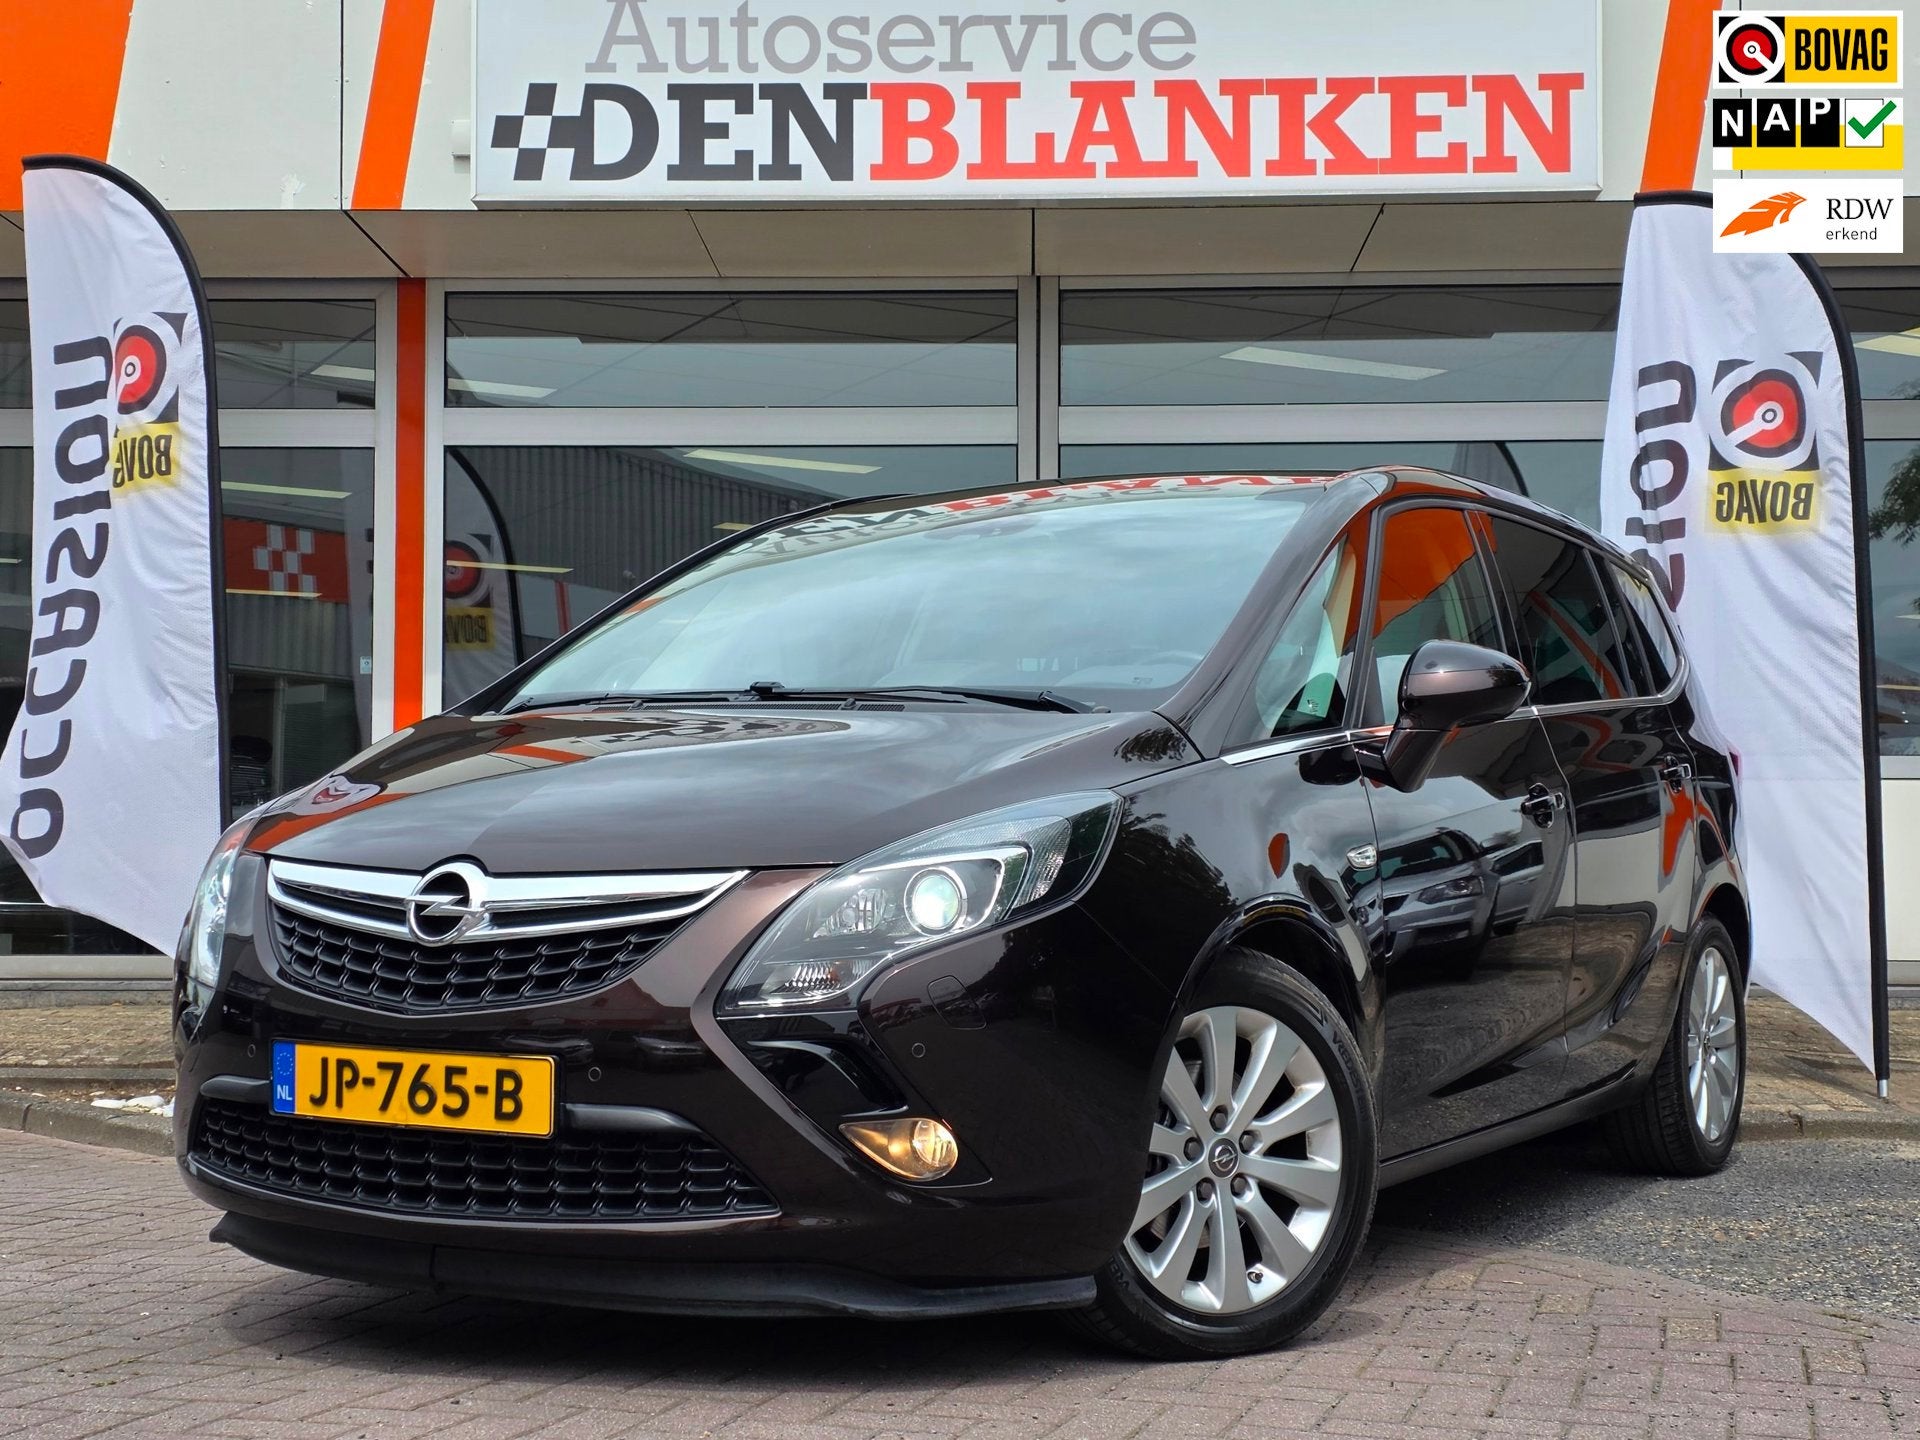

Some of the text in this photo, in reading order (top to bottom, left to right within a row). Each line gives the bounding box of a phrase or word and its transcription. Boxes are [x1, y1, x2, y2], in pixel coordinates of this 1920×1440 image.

[585, 0, 1197, 74] Autoservice
[277, 1084, 293, 1101] NL
[309, 1057, 524, 1121] JP-765-B
